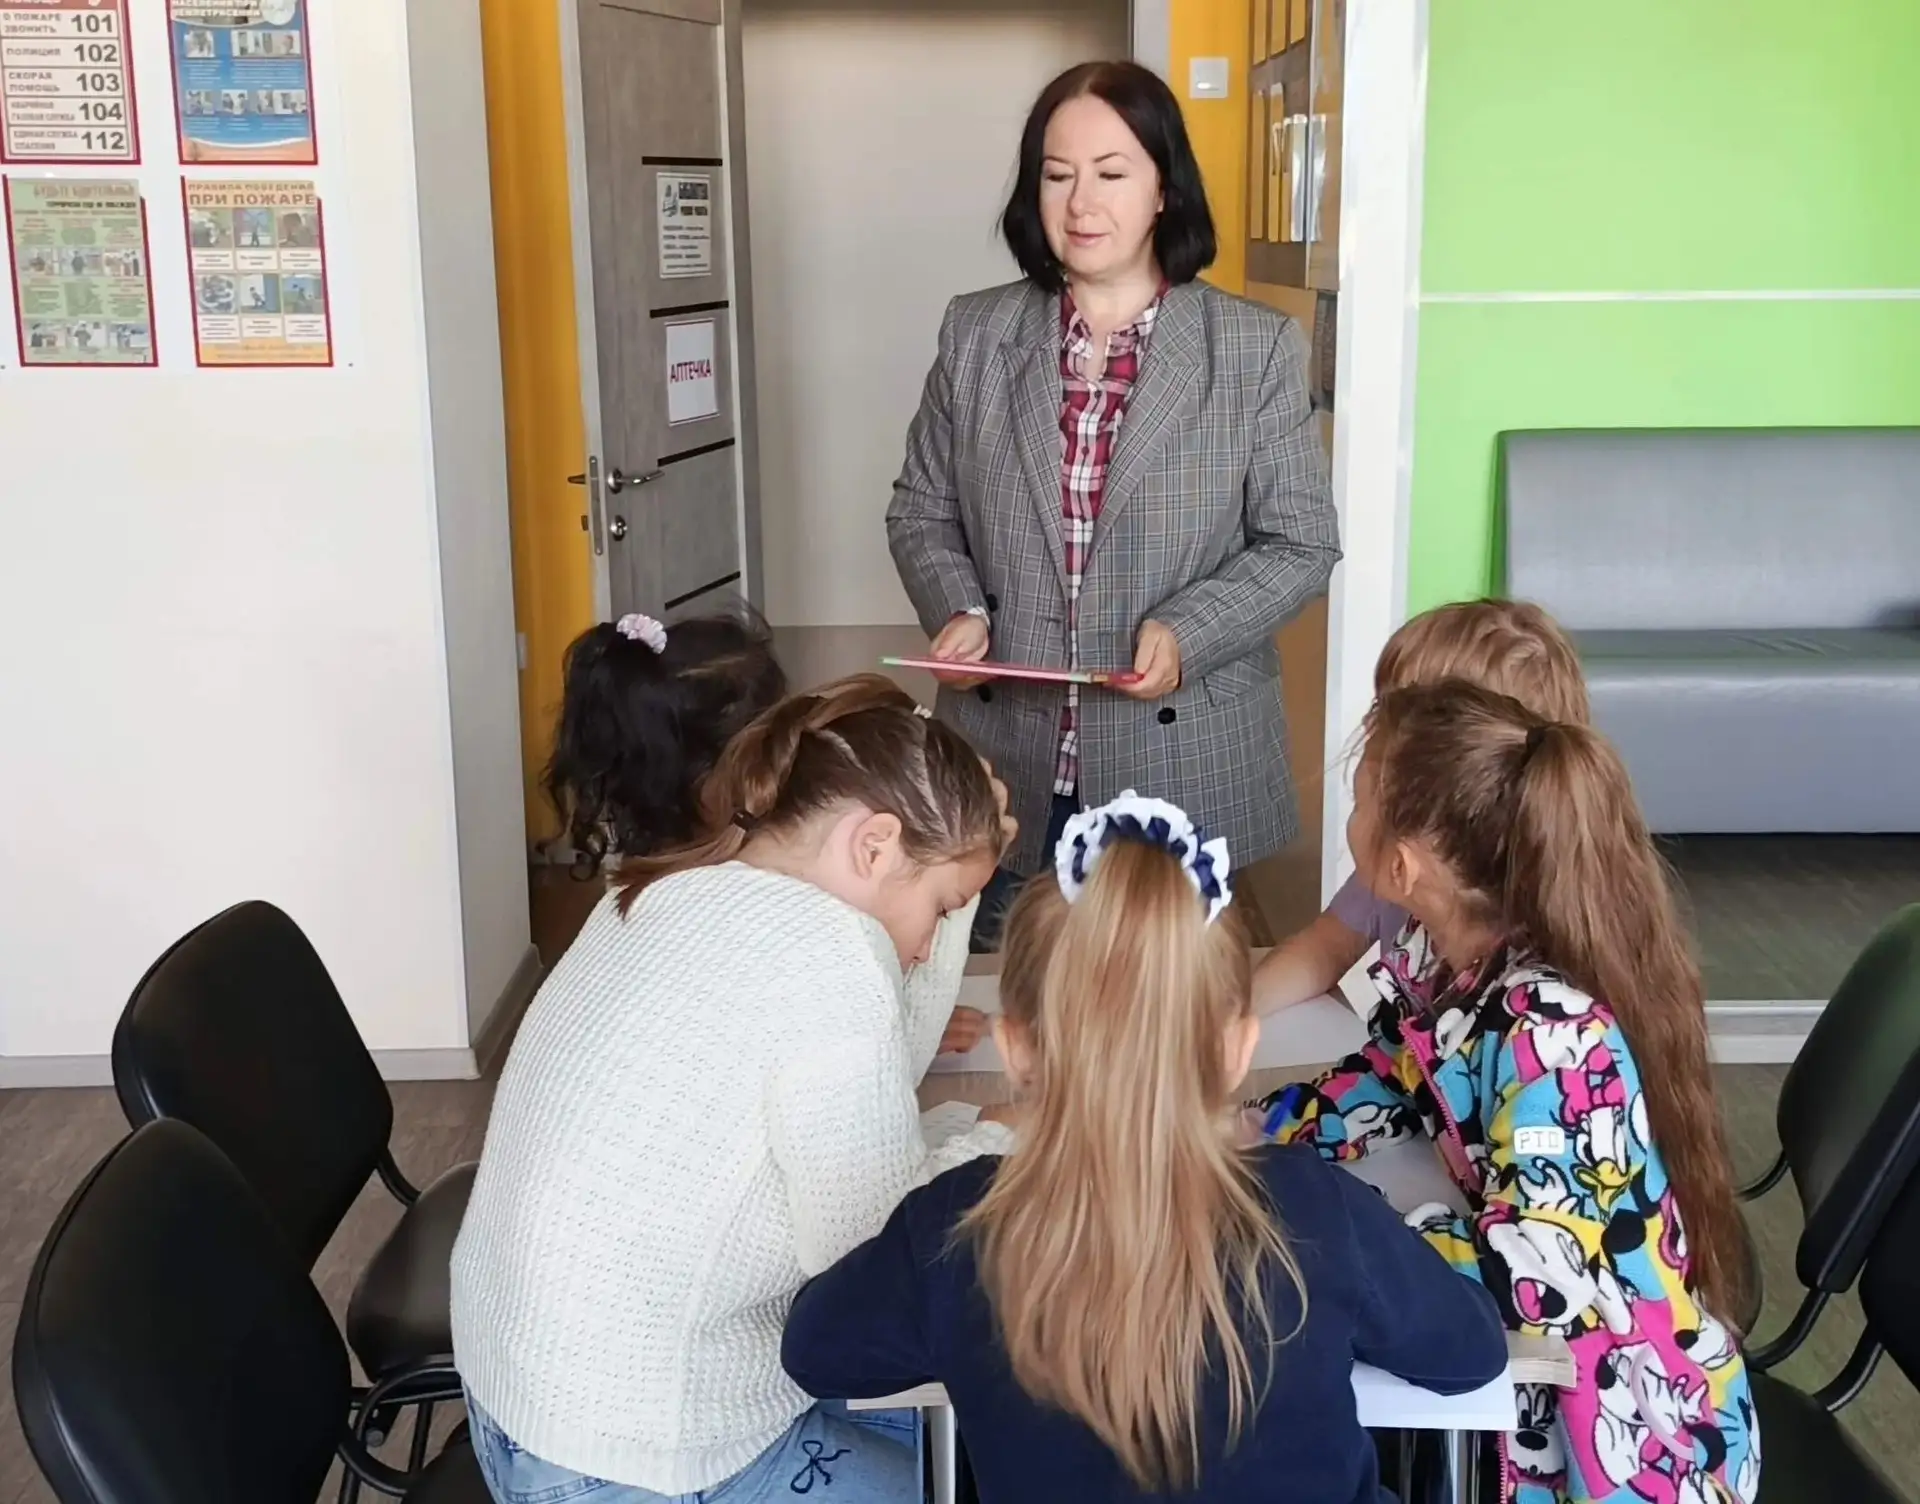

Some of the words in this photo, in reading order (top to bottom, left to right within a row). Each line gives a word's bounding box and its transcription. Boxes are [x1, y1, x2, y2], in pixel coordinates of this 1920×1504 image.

[14, 13, 62, 21] ПОЖАРЕ
[4, 25, 57, 33] ЗВОНИТЬ
[71, 14, 113, 33] 101
[6, 48, 61, 56] ПОЛИЦИЯ
[74, 44, 118, 62] 102
[9, 72, 52, 80] СКОРАЯ
[10, 84, 60, 93] ПОМОЩЬ
[76, 73, 120, 92] 103
[79, 102, 122, 121] 104
[81, 131, 125, 150] 112
[188, 183, 243, 191] ПРАВИЛА
[189, 194, 228, 205] ПРИ
[233, 193, 315, 205] ПОЖАРЕ
[670, 359, 711, 384] АПТЕЧКА
